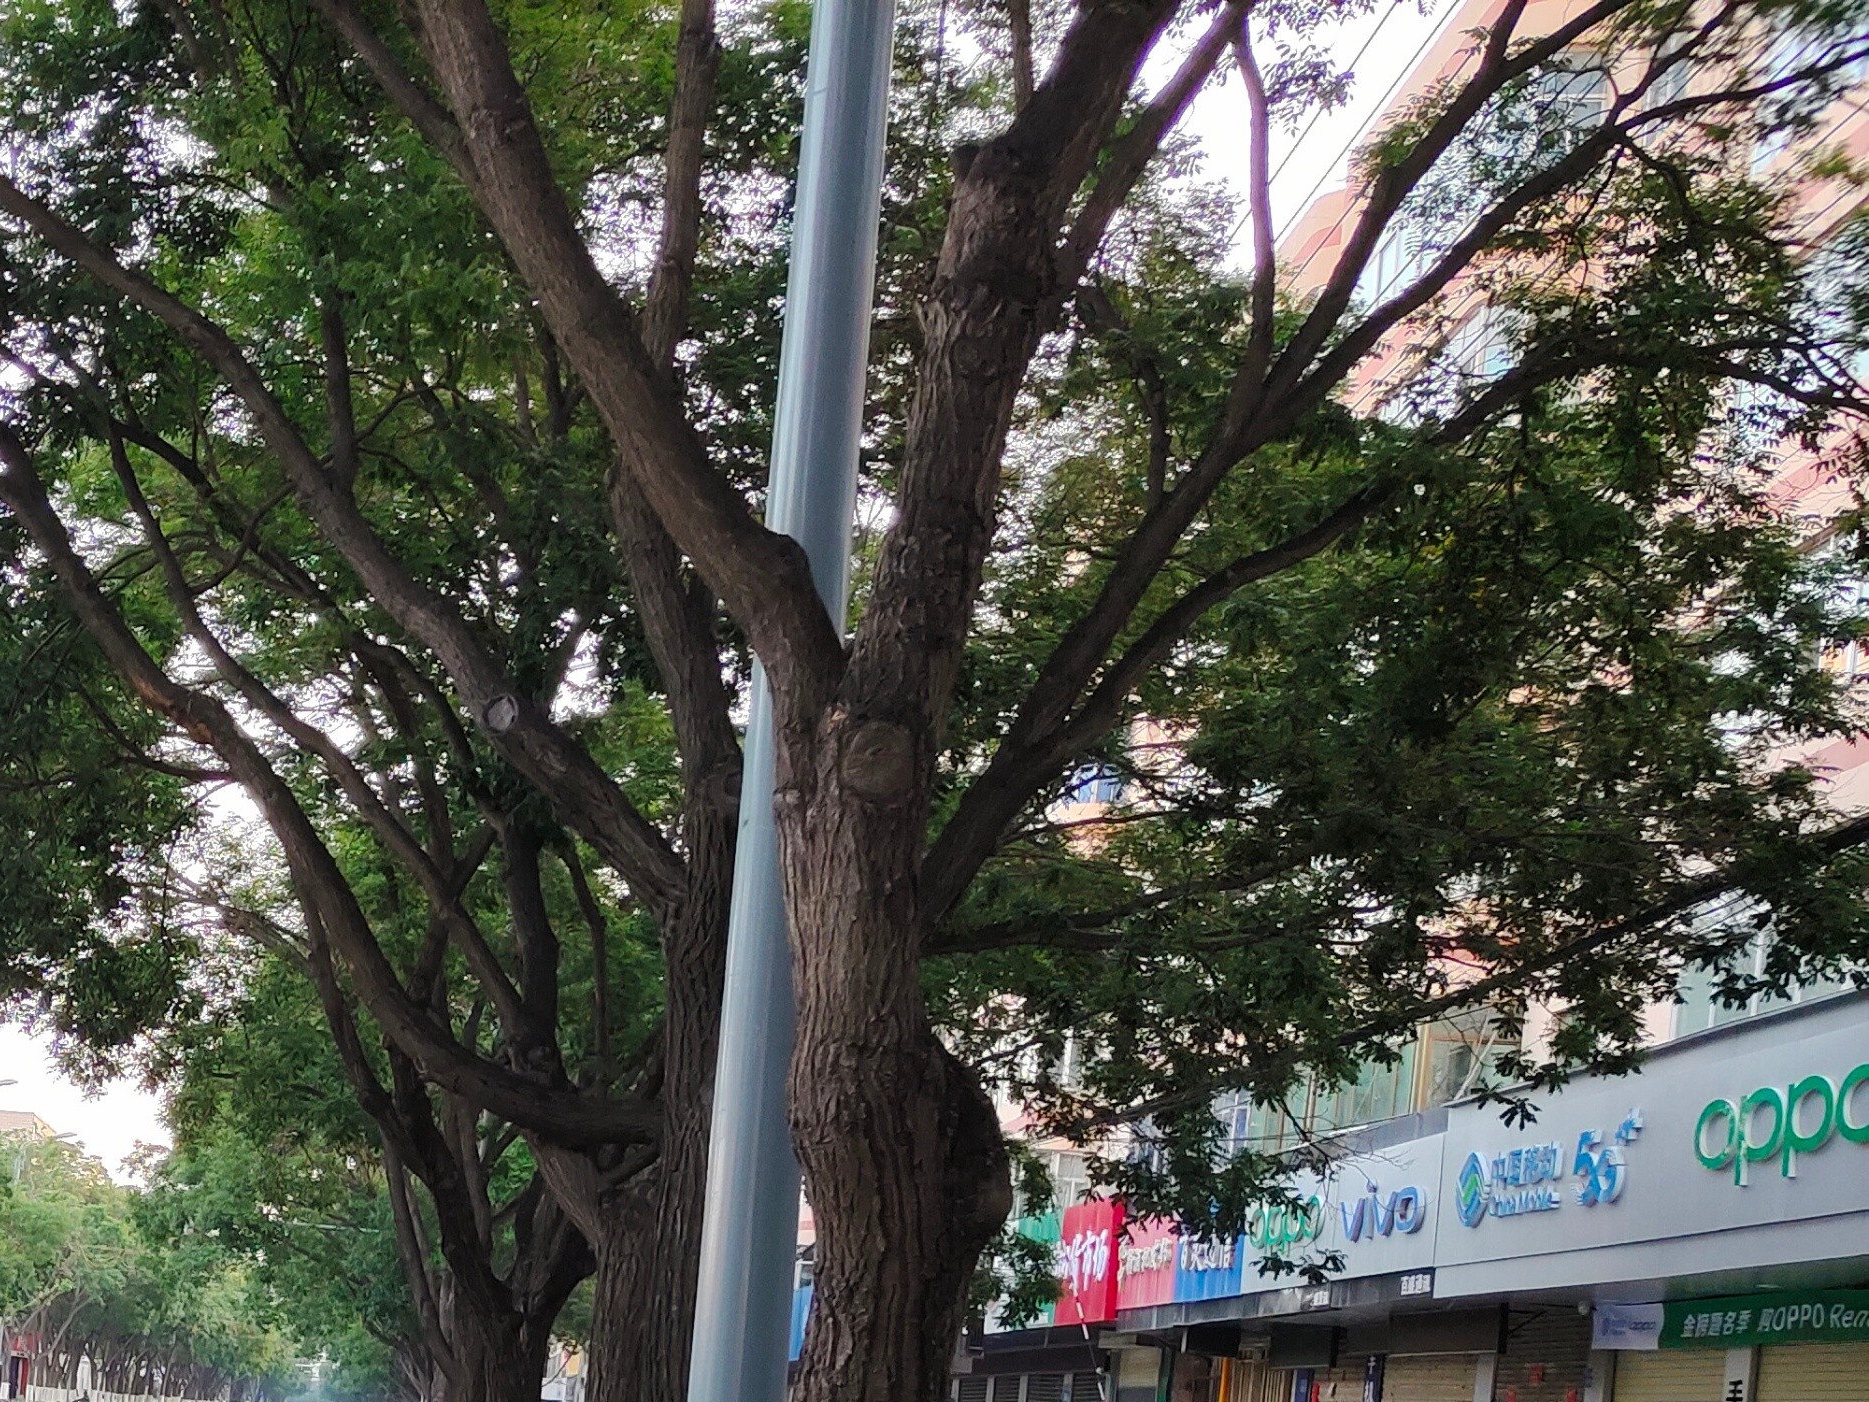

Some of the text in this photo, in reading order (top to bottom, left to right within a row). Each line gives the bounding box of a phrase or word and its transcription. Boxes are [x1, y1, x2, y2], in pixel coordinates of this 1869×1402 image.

[1694, 1063, 1869, 1187] oppo
[1491, 1140, 1564, 1190] 中国移动
[1340, 1179, 1425, 1243] vivo
[1830, 1303, 1869, 1329] Ren
